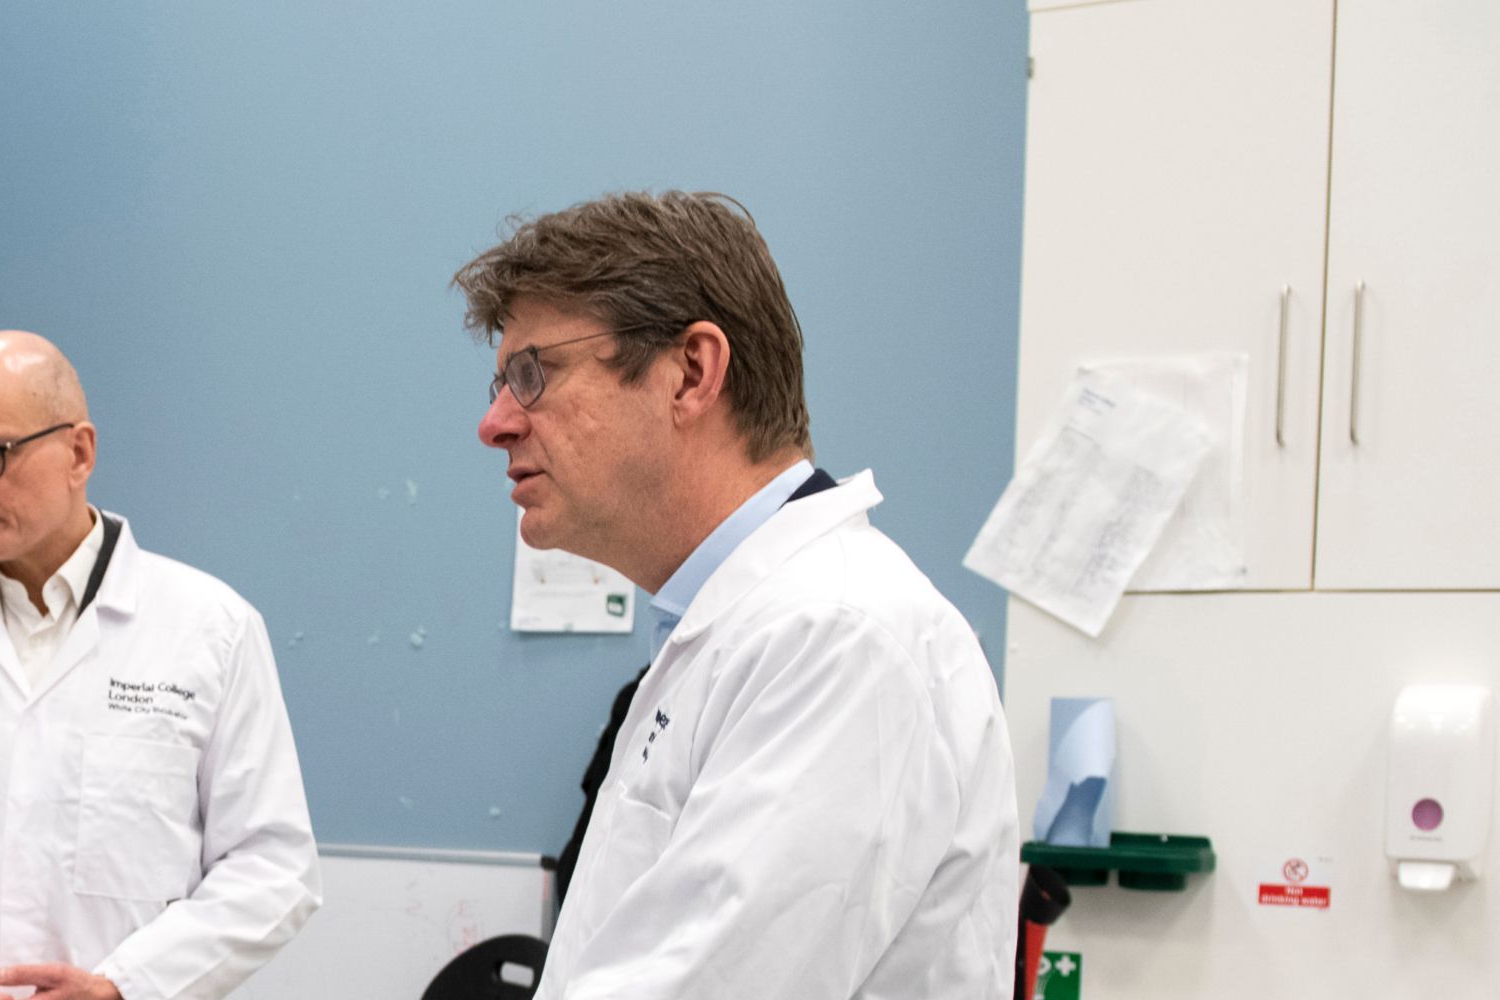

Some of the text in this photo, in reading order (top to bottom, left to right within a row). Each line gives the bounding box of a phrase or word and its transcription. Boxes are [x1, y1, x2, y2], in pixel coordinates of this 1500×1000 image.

[108, 690, 154, 703] London
[110, 678, 196, 700] Imperial College
